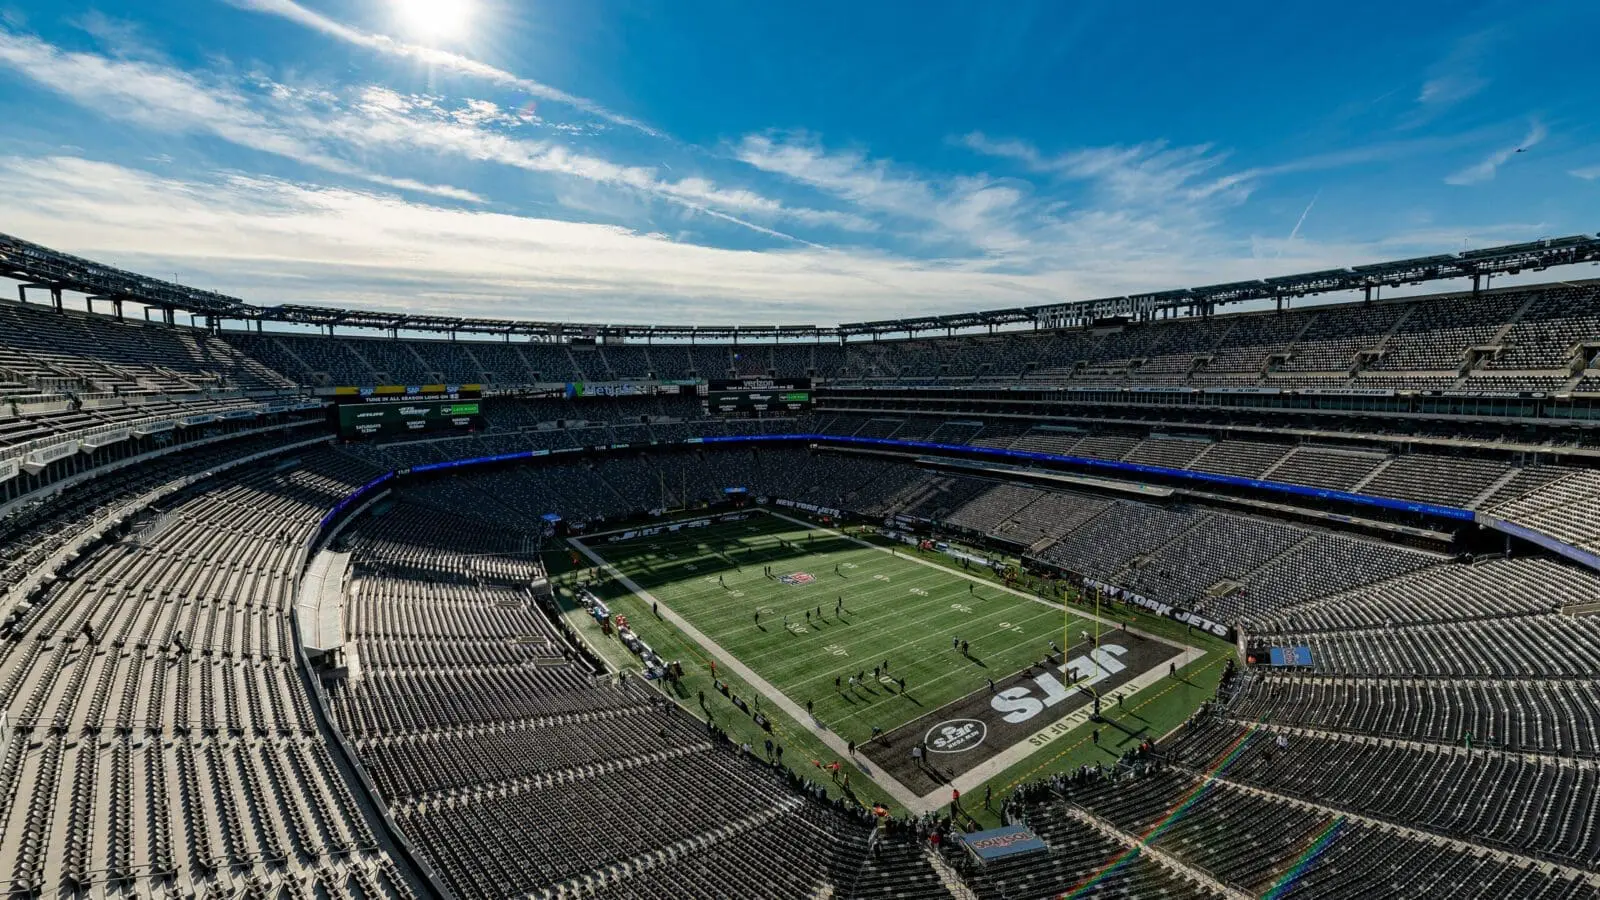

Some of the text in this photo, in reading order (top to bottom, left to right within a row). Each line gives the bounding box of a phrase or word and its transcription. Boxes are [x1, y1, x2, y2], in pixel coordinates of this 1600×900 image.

[1037, 295, 1155, 322] METLIFE STADIUM
[743, 378, 774, 388] verizon
[776, 498, 840, 518] NEW YORK JETS
[1122, 591, 1174, 616] YORK
[1175, 612, 1229, 637] JETS
[990, 644, 1129, 724] JETS
[1114, 683, 1139, 693] IT
[1066, 707, 1092, 723] ALL
[933, 723, 975, 748] JETS
[1051, 722, 1070, 735] OF
[1028, 733, 1050, 747] US
